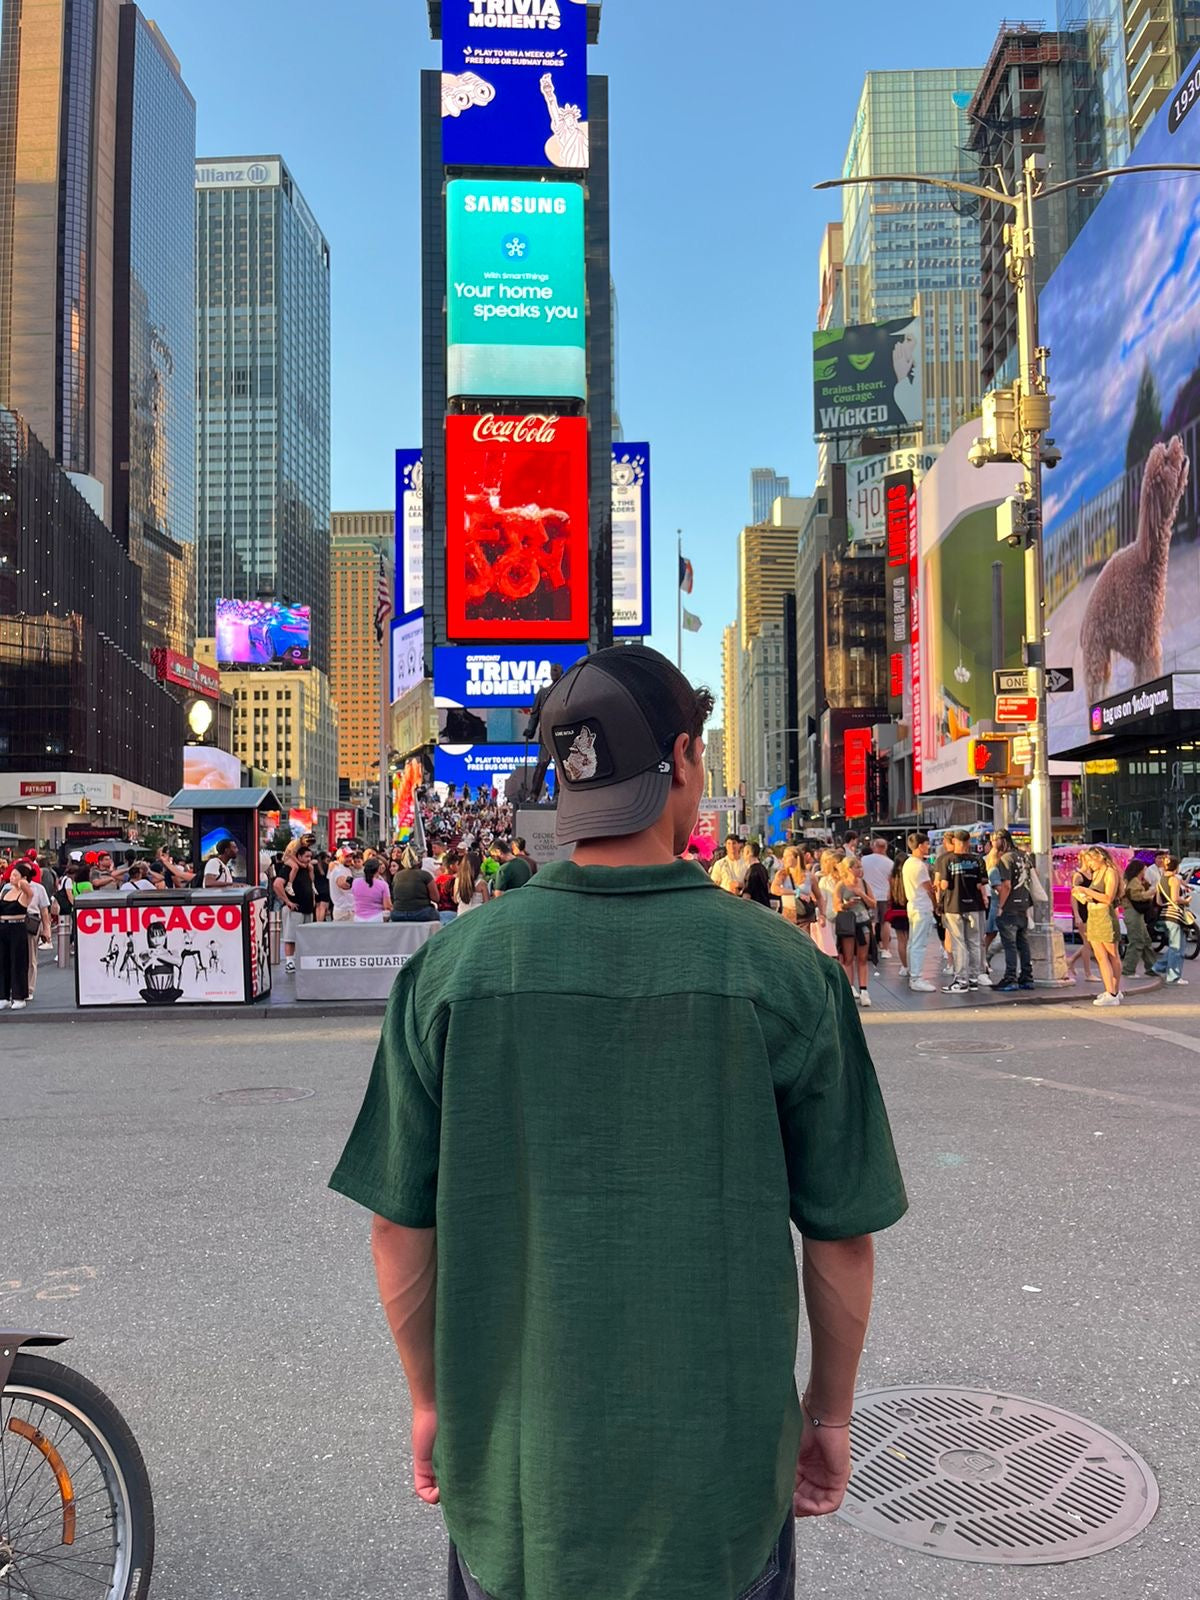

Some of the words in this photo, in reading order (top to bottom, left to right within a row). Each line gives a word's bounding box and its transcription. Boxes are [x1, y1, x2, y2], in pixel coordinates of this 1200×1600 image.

[468, 0, 561, 16] TRIVIA
[468, 13, 561, 30] MOMENTS
[465, 57, 484, 65] FREE
[485, 58, 500, 66] BUS
[501, 58, 511, 66] OR
[512, 58, 542, 66] SUBWAY
[543, 59, 564, 67] RIDES
[474, 49, 492, 57] PLAY
[493, 50, 503, 58] TO
[504, 50, 518, 58] WIN
[545, 51, 555, 59] OF
[464, 194, 567, 215] SAMSUNG
[484, 272, 501, 280] With
[502, 272, 549, 282] SmartThings
[454, 282, 495, 298] Your
[499, 283, 553, 299] home
[474, 303, 540, 321] speaks
[544, 306, 578, 323] you
[822, 385, 855, 396] Brains.
[857, 381, 887, 391] Heart.
[833, 392, 875, 403] Courage.
[857, 454, 903, 486] LITTLE
[907, 454, 937, 471] SHO
[893, 587, 905, 613] PLAY
[466, 660, 552, 681] TRIVIA
[1006, 677, 1028, 688] ONE
[1103, 707, 1114, 725] tag
[1114, 705, 1122, 720] us
[1122, 701, 1132, 716] on
[1132, 689, 1169, 715] Instagram
[467, 763, 483, 771] FREE
[484, 763, 498, 771] BUS
[499, 763, 508, 771] OR
[475, 756, 492, 764] PLAY
[492, 756, 500, 764] TO
[501, 756, 514, 764] WIN
[77, 905, 242, 934] CHICAGO
[317, 957, 356, 968] TIMES
